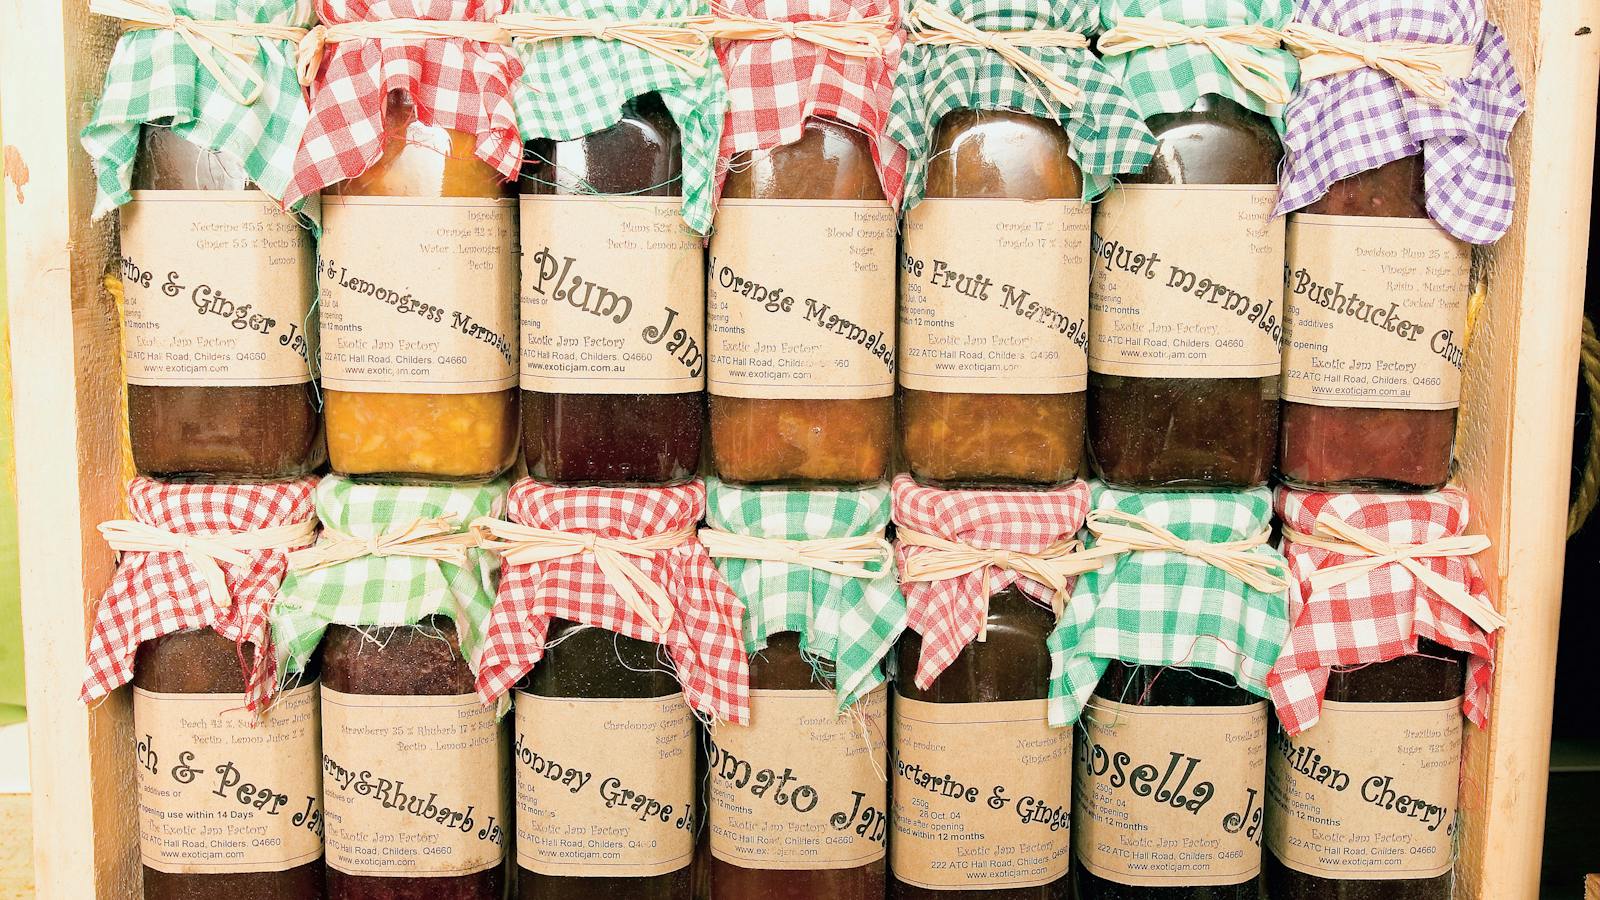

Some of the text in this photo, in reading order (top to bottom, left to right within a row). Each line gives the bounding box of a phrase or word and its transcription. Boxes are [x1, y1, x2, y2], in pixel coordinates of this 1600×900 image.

[930, 260, 993, 301] Fruit
[327, 260, 337, 279] &
[338, 267, 444, 323] Lemongrass
[720, 266, 795, 313] Orange
[161, 271, 185, 297] &
[192, 285, 276, 335] Ginger
[1293, 268, 1425, 342] Bushtucker
[533, 247, 703, 378] Plum Jam
[910, 307, 935, 316] opening
[1109, 306, 1139, 315] months
[334, 324, 362, 332] months
[915, 318, 954, 328] 12 months
[1299, 320, 1333, 329] additives
[719, 325, 745, 334] months
[372, 340, 393, 350] Jam
[399, 340, 440, 352] Factory
[528, 334, 625, 348] Exotic Jam Factory
[964, 335, 987, 346] Jam
[1107, 337, 1140, 346] ATC Hall
[1293, 341, 1328, 352] opening
[334, 354, 467, 364] ATC Hall Q4660
[524, 349, 536, 358] ATC
[623, 353, 652, 361] Q4660
[909, 348, 956, 358] 222 ATC Hall
[528, 362, 625, 372] www.exoticjam.com.au
[733, 357, 747, 366] Hall
[1312, 357, 1417, 373] Exotic Jam Factory
[1288, 369, 1440, 386] 222 ATC Hall Road, Q4660
[417, 726, 456, 735] Rhubarb
[172, 751, 204, 783] &
[212, 761, 288, 815] Pear
[1096, 783, 1113, 795] 250g
[987, 786, 1010, 809] &
[1080, 735, 1263, 848] Rosella Ja
[1305, 791, 1315, 800] 04
[600, 777, 672, 822] Grape
[912, 798, 929, 809] 250g
[1361, 775, 1447, 832] Cherry
[725, 802, 753, 814] months
[1292, 800, 1321, 814] opening
[186, 810, 214, 818] within
[230, 811, 253, 820] Days
[1101, 807, 1129, 820] opening
[1297, 810, 1341, 827] 12 months
[163, 824, 268, 836] Exotic Jam Factory
[931, 823, 964, 832] opening
[1105, 817, 1148, 831] 12 months
[340, 829, 439, 844] Exotic Jam Factory
[565, 824, 586, 835] Jam
[591, 825, 630, 837] Factory
[912, 830, 935, 840] within
[1311, 829, 1370, 843] Exotic Jam
[151, 836, 280, 848] ATC Hall Q4660
[723, 830, 755, 844] ATC Hall
[1157, 837, 1221, 848] Jam Factory
[341, 844, 352, 853] Hall
[423, 847, 451, 855] Q4660
[957, 844, 1015, 857] Exotic Jam
[1098, 843, 1243, 859] 222 ATC Hall Q4660
[1289, 836, 1436, 855] 222 ATC Hall Q4660
[161, 850, 244, 859] www.exoticjam.com
[538, 848, 620, 859] www.exoticjam.com
[338, 854, 415, 866] www.exoticjam.com
[931, 859, 987, 868] 222 ATC Hall
[1319, 856, 1402, 866] www.exoticjam.com
[1128, 862, 1209, 871] www.exoticjam.com
[966, 867, 1047, 879] www.exoticjam.com
